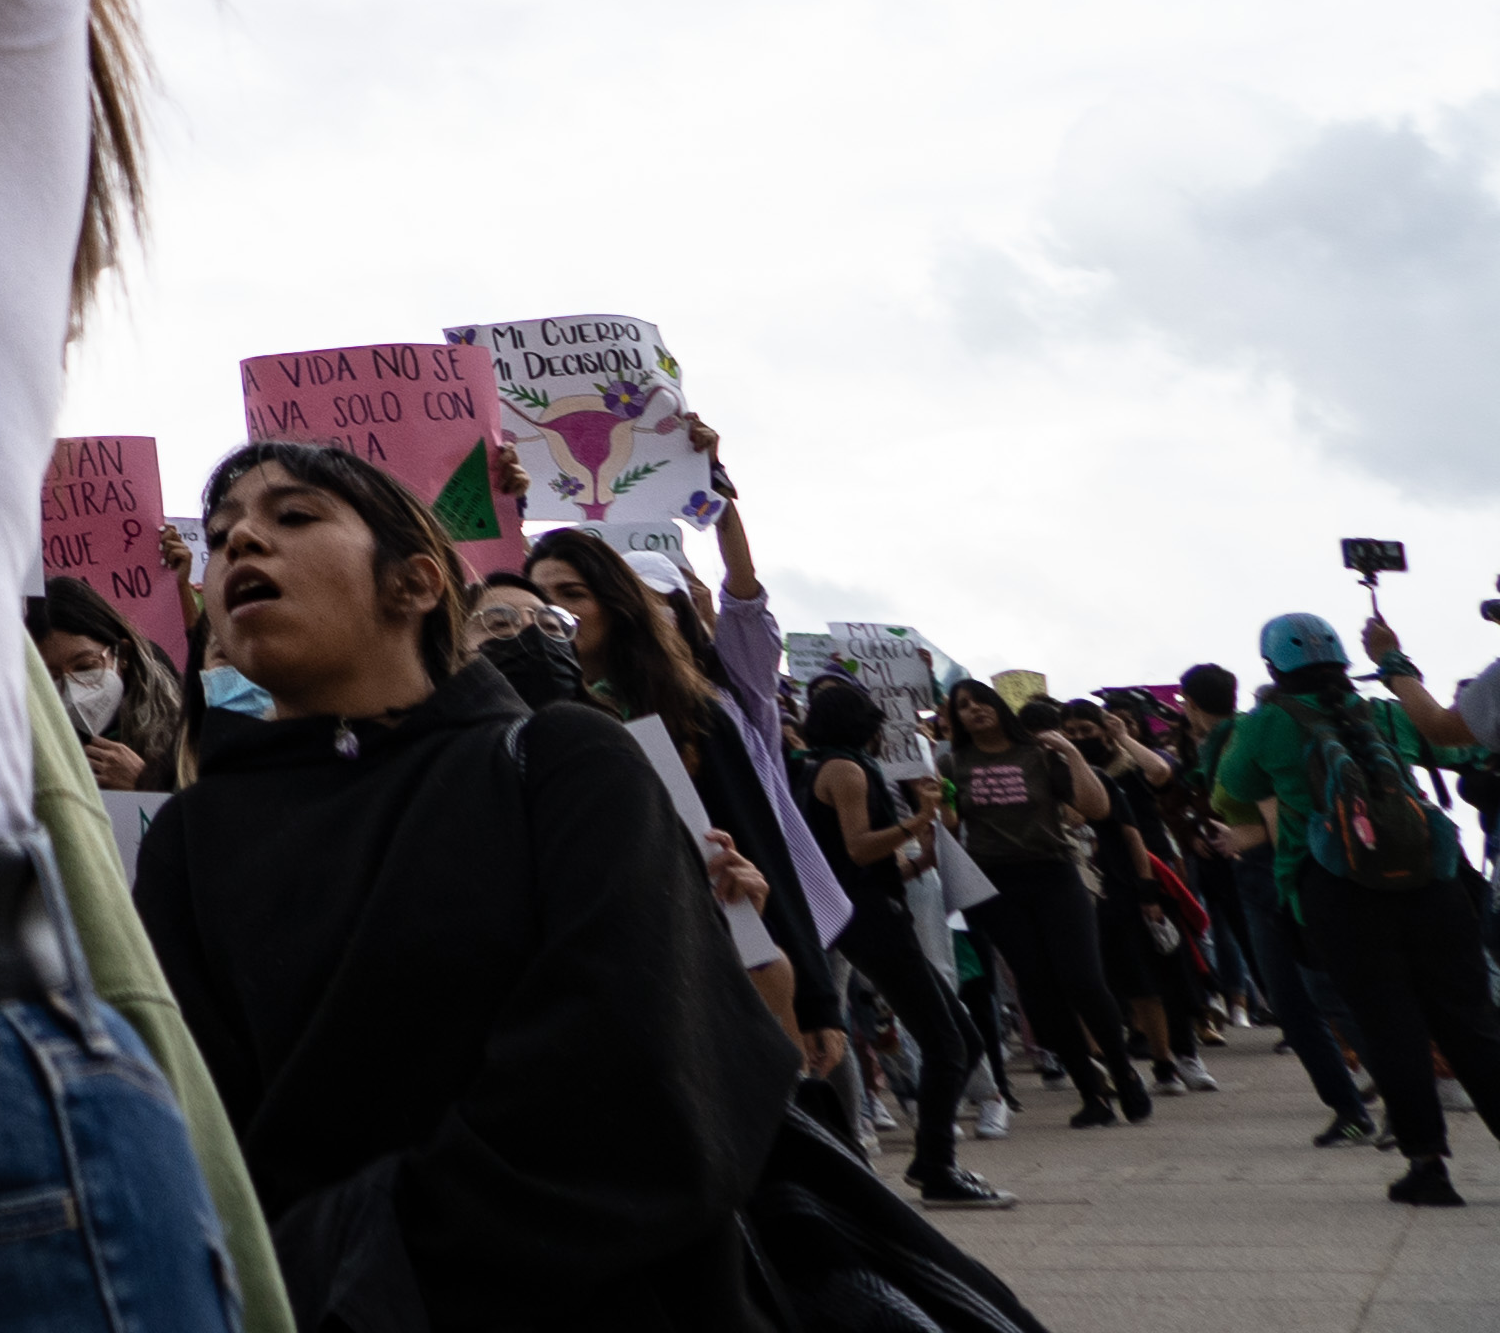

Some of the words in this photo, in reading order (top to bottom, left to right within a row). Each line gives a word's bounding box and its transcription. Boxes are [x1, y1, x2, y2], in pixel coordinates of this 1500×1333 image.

[541, 318, 642, 347] CUERPO
[278, 351, 357, 389] VIDA
[372, 346, 421, 381] NO
[432, 348, 465, 382] SE
[333, 390, 401, 429] SOLO
[424, 386, 476, 422] CON
[628, 531, 681, 551] con
[110, 565, 153, 599] NO
